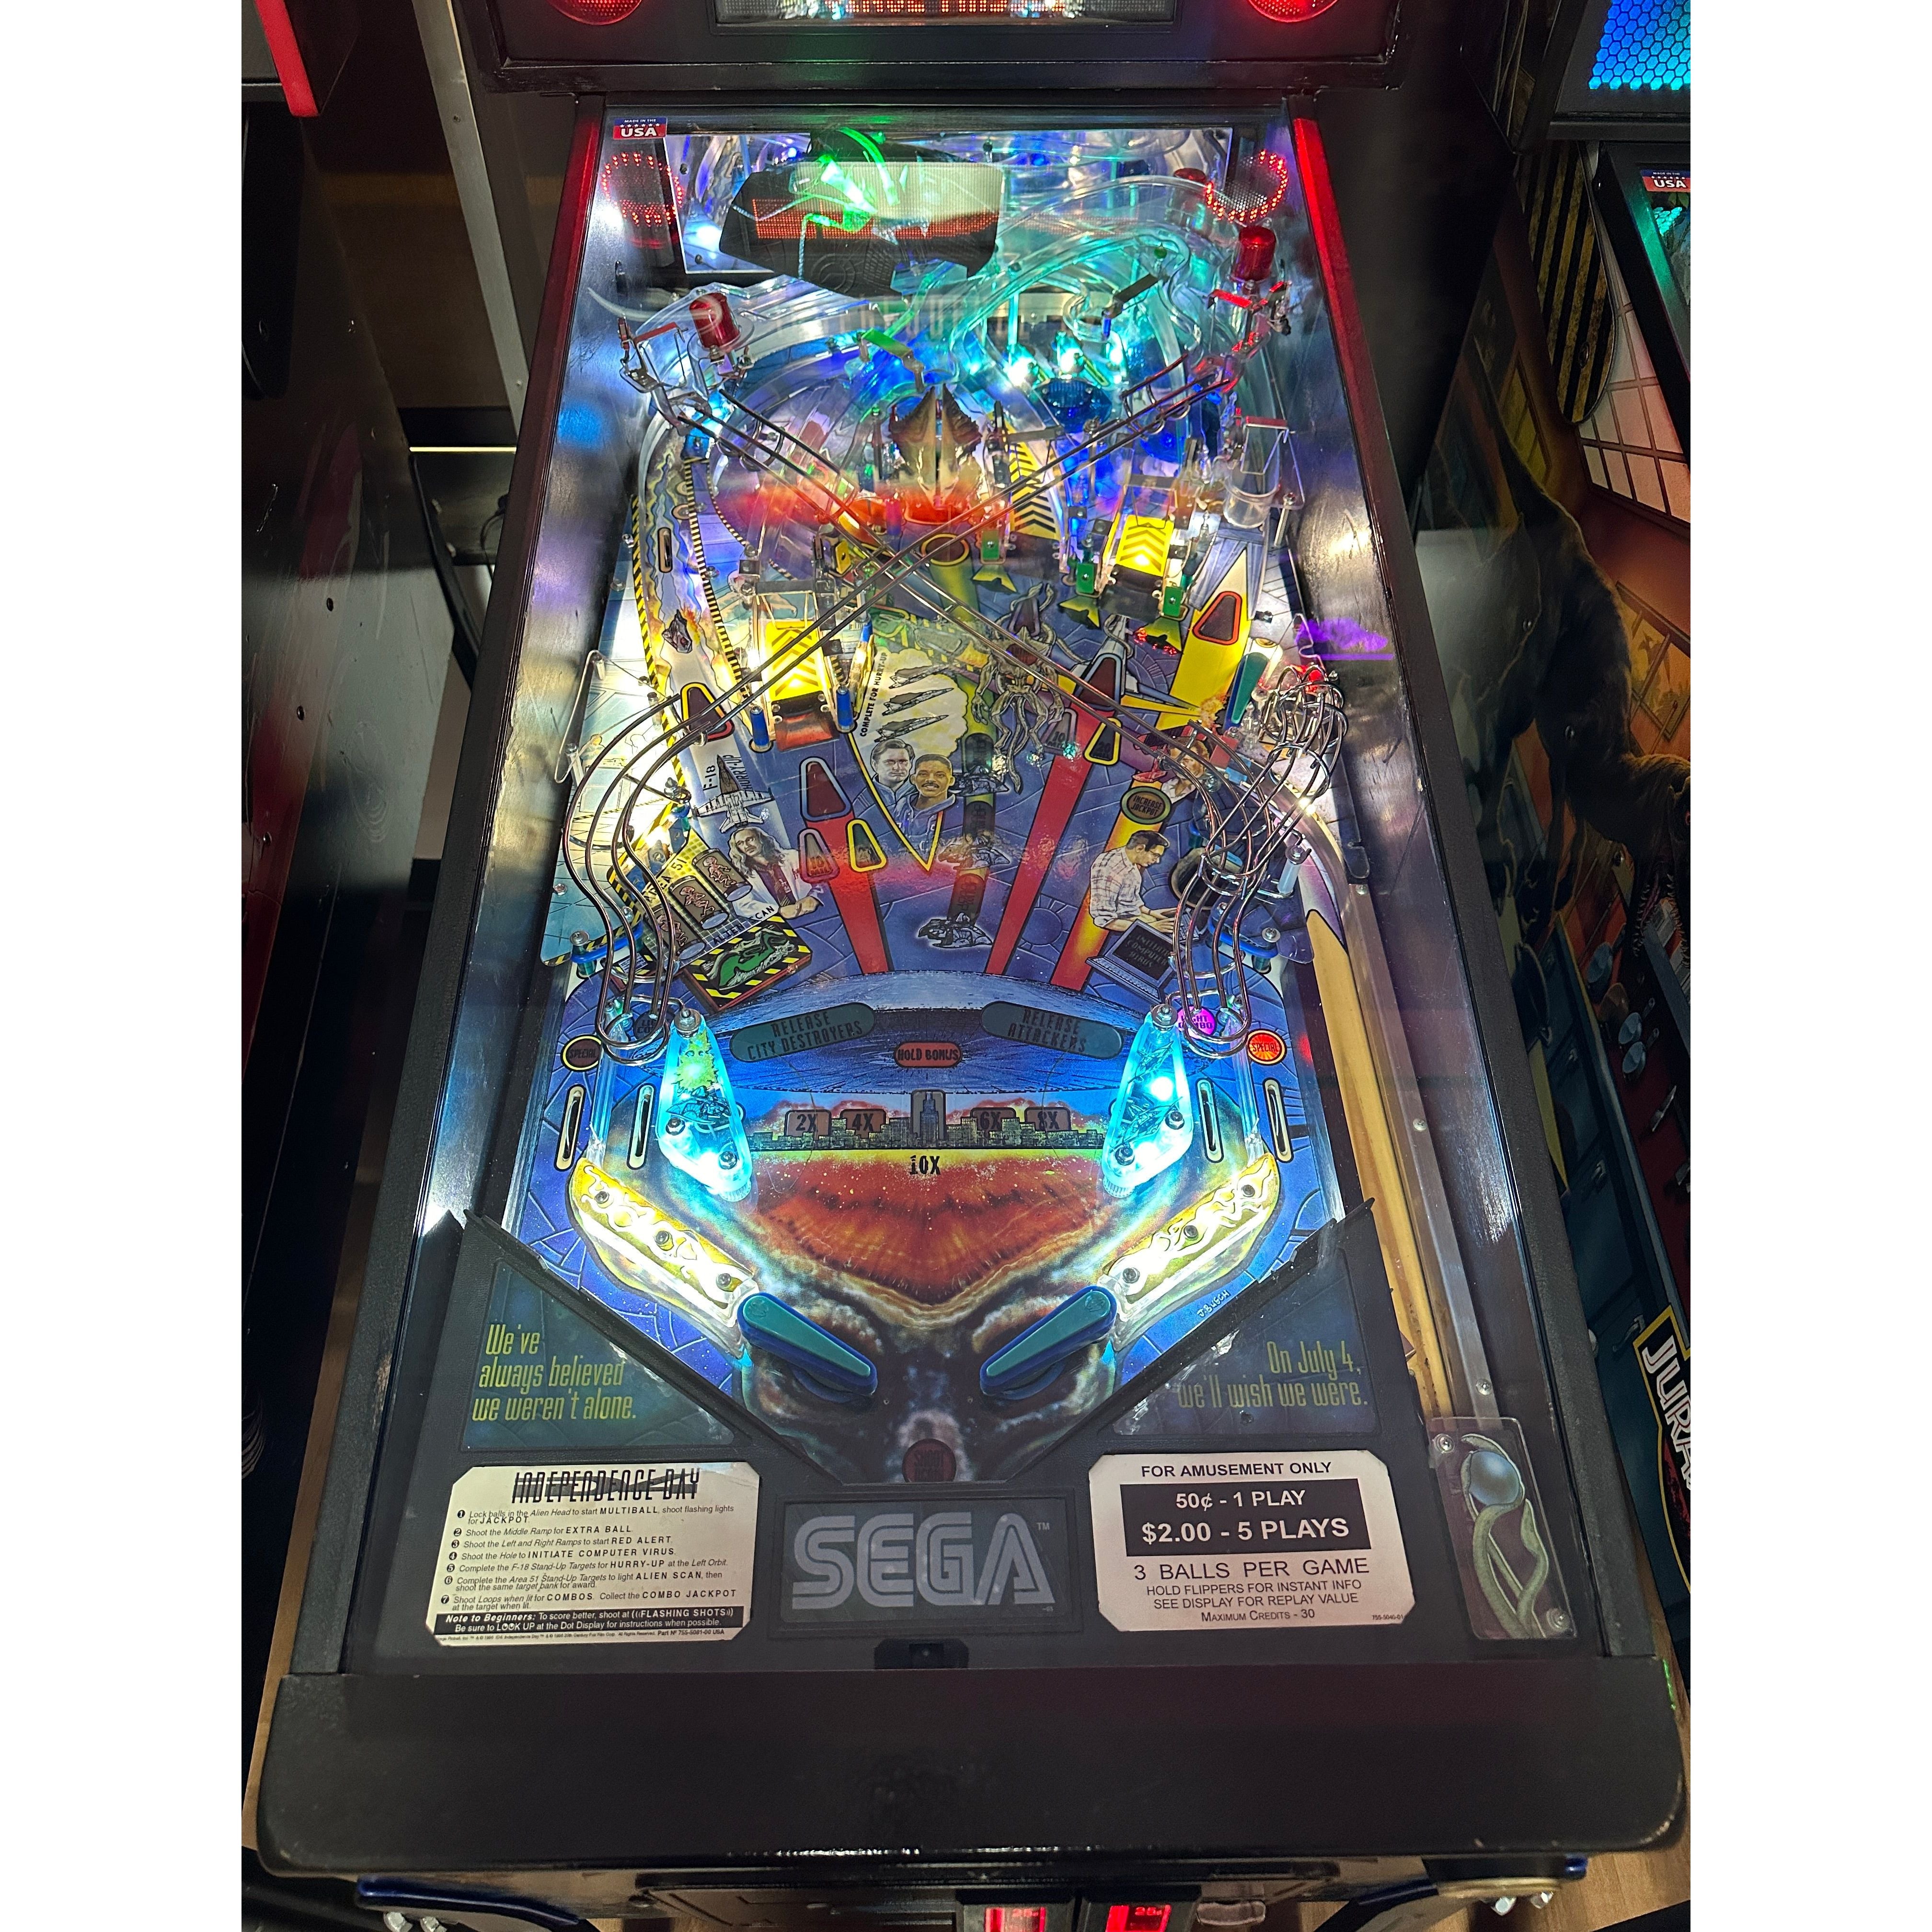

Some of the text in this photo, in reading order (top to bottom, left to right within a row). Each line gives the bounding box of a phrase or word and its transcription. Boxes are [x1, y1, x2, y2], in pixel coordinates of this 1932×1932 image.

[621, 127, 657, 137] USA
[1654, 180, 1687, 188] USA
[860, 652, 887, 736] COMPLETE FOR HURRY-UP
[703, 765, 718, 791] F-18
[723, 755, 753, 792] HURRY-UP
[1130, 803, 1159, 816] JACKPOT
[1133, 795, 1162, 810] INCREASE
[671, 858, 687, 870] 51
[713, 923, 745, 944] ALIEN
[1127, 940, 1167, 966] COMPUTER
[770, 1012, 830, 1037] RELEASE
[1023, 1008, 1080, 1034] RELEASE
[748, 1021, 862, 1060] CITY DESTROYERS
[1008, 1023, 1086, 1052] ATTACKERS
[1252, 1042, 1279, 1052] SPECIAL
[569, 1048, 597, 1059] SPECIAL
[897, 1048, 958, 1061] HOLD BONUS
[796, 1114, 818, 1131] 2X
[851, 1111, 874, 1131] 4X
[979, 1112, 1001, 1130] 6X
[1037, 1111, 1058, 1130] 8X
[909, 1155, 941, 1175] 10X
[485, 1324, 540, 1355] We've
[1267, 1340, 1361, 1381] On July 4,
[479, 1355, 625, 1395] always believed
[1177, 1374, 1368, 1408] we'll wish we were.
[472, 1387, 636, 1421] we weren't alone.
[1141, 1461, 1332, 1477] FOR AMUSEMENT ONLY
[511, 1468, 700, 1504] INDEPENDENCE DAY
[1175, 1489, 1306, 1511] 50¢ 1 PLAY
[600, 1506, 660, 1515] MULTIBALL,
[685, 1506, 713, 1514] flashing
[715, 1505, 734, 1514] lights
[530, 1528, 552, 1536] Ramp
[566, 1526, 600, 1534] EXTRA
[1142, 1518, 1349, 1545] $2.00 5 PLAYS
[534, 1539, 553, 1548] Right
[556, 1538, 582, 1547] Ramps
[578, 1549, 637, 1557] COMPUTER
[792, 1512, 1055, 1610] SEGA
[460, 1564, 494, 1573] Complete
[531, 1562, 567, 1571] Stand-Up
[569, 1562, 595, 1570] Targets
[610, 1560, 665, 1569] HURRY-UP
[1134, 1557, 1370, 1580] 3 BALLS PER GAME
[1147, 1579, 1362, 1597] HOLD FLIPPERS FOR INSTANT INFO
[1154, 1592, 1359, 1609] SEE DISPLAY FOR REPLAY VALUE
[446, 1615, 468, 1623] Note
[484, 1613, 536, 1623] Beginners:
[573, 1611, 597, 1620] better,
[1300, 1609, 1315, 1619] 30
[576, 1620, 604, 1630] Display
[620, 1619, 663, 1628] instructions
[688, 1619, 721, 1628] possible.
